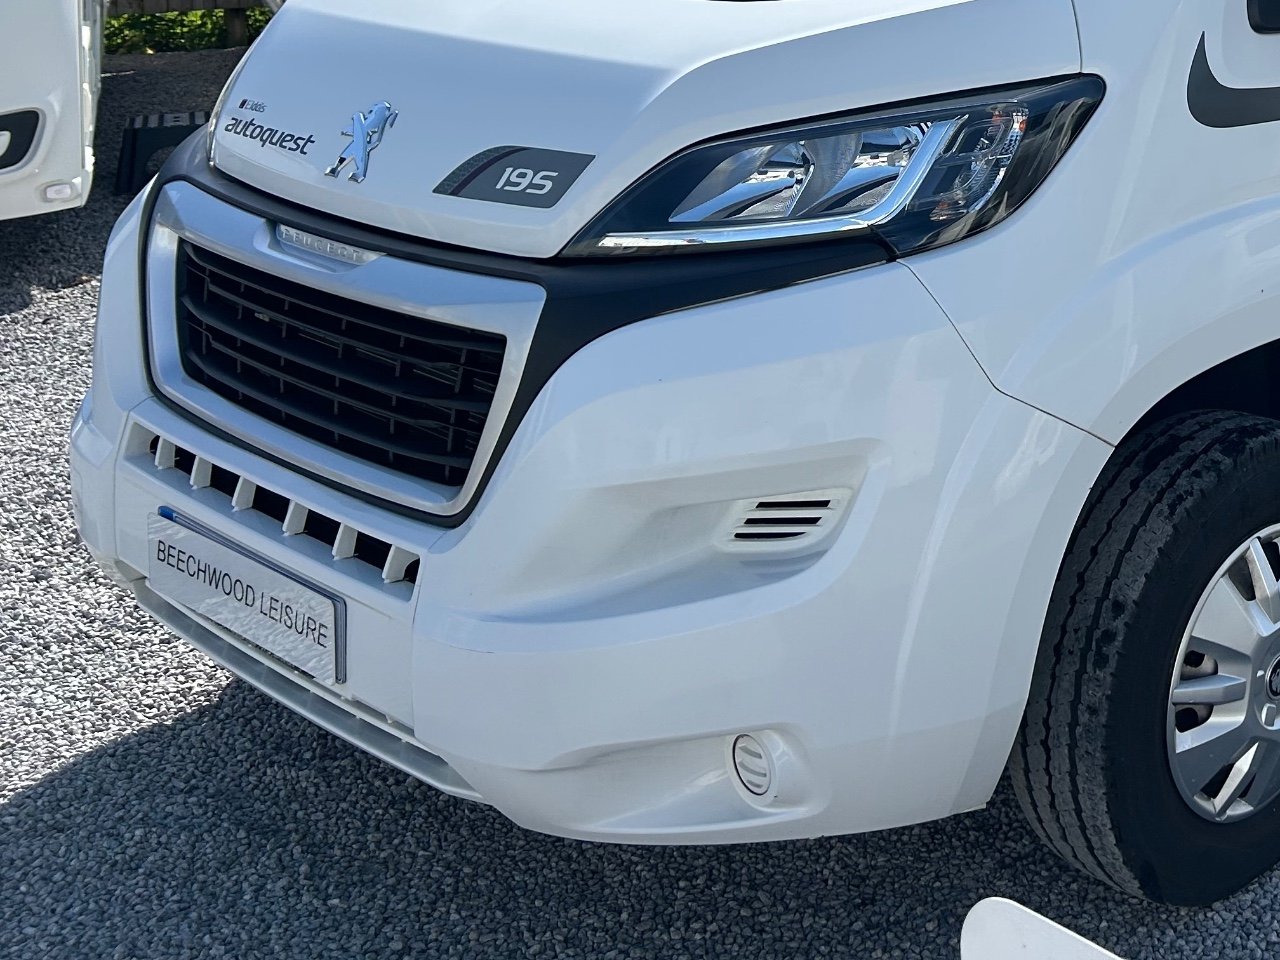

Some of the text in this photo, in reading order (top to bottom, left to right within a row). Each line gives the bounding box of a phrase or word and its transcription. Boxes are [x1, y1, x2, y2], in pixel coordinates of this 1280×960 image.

[224, 117, 315, 155] autoquest
[496, 167, 559, 195] 195
[281, 228, 360, 261] PEUGEOT
[157, 540, 328, 649] BEECHWOOD LEISURE
